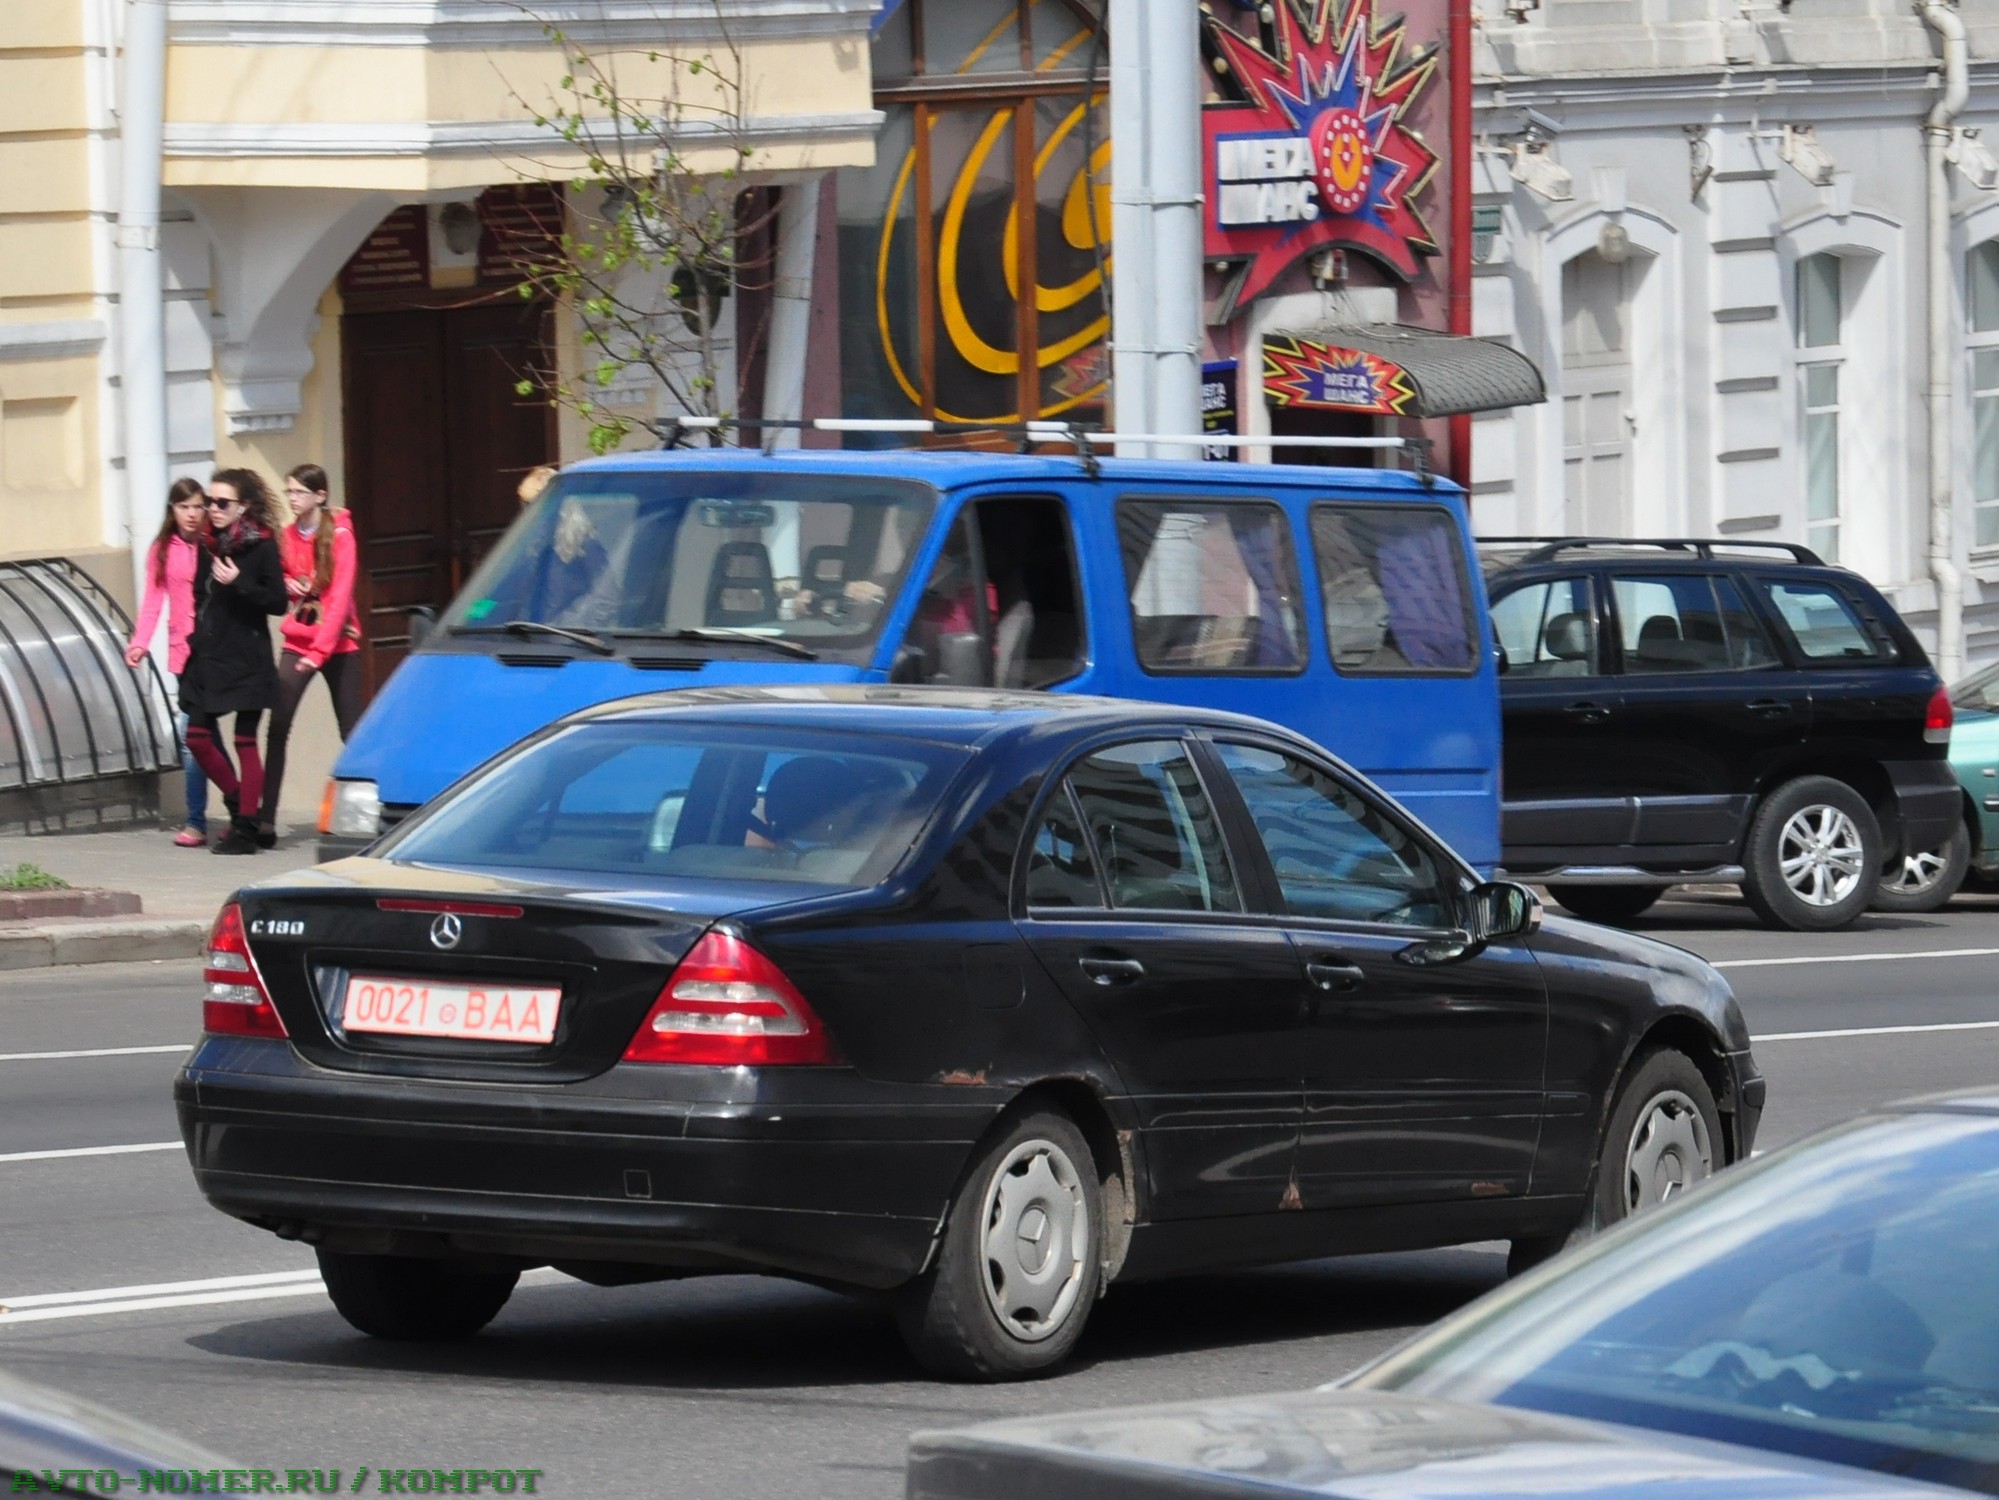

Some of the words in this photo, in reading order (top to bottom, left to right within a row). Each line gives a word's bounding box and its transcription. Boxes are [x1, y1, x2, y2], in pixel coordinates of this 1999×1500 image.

[1324, 372, 1369, 388] МЕГА
[251, 920, 264, 934] C
[267, 920, 305, 935] 180
[356, 984, 430, 1025] 0021
[464, 991, 541, 1034] BAA
